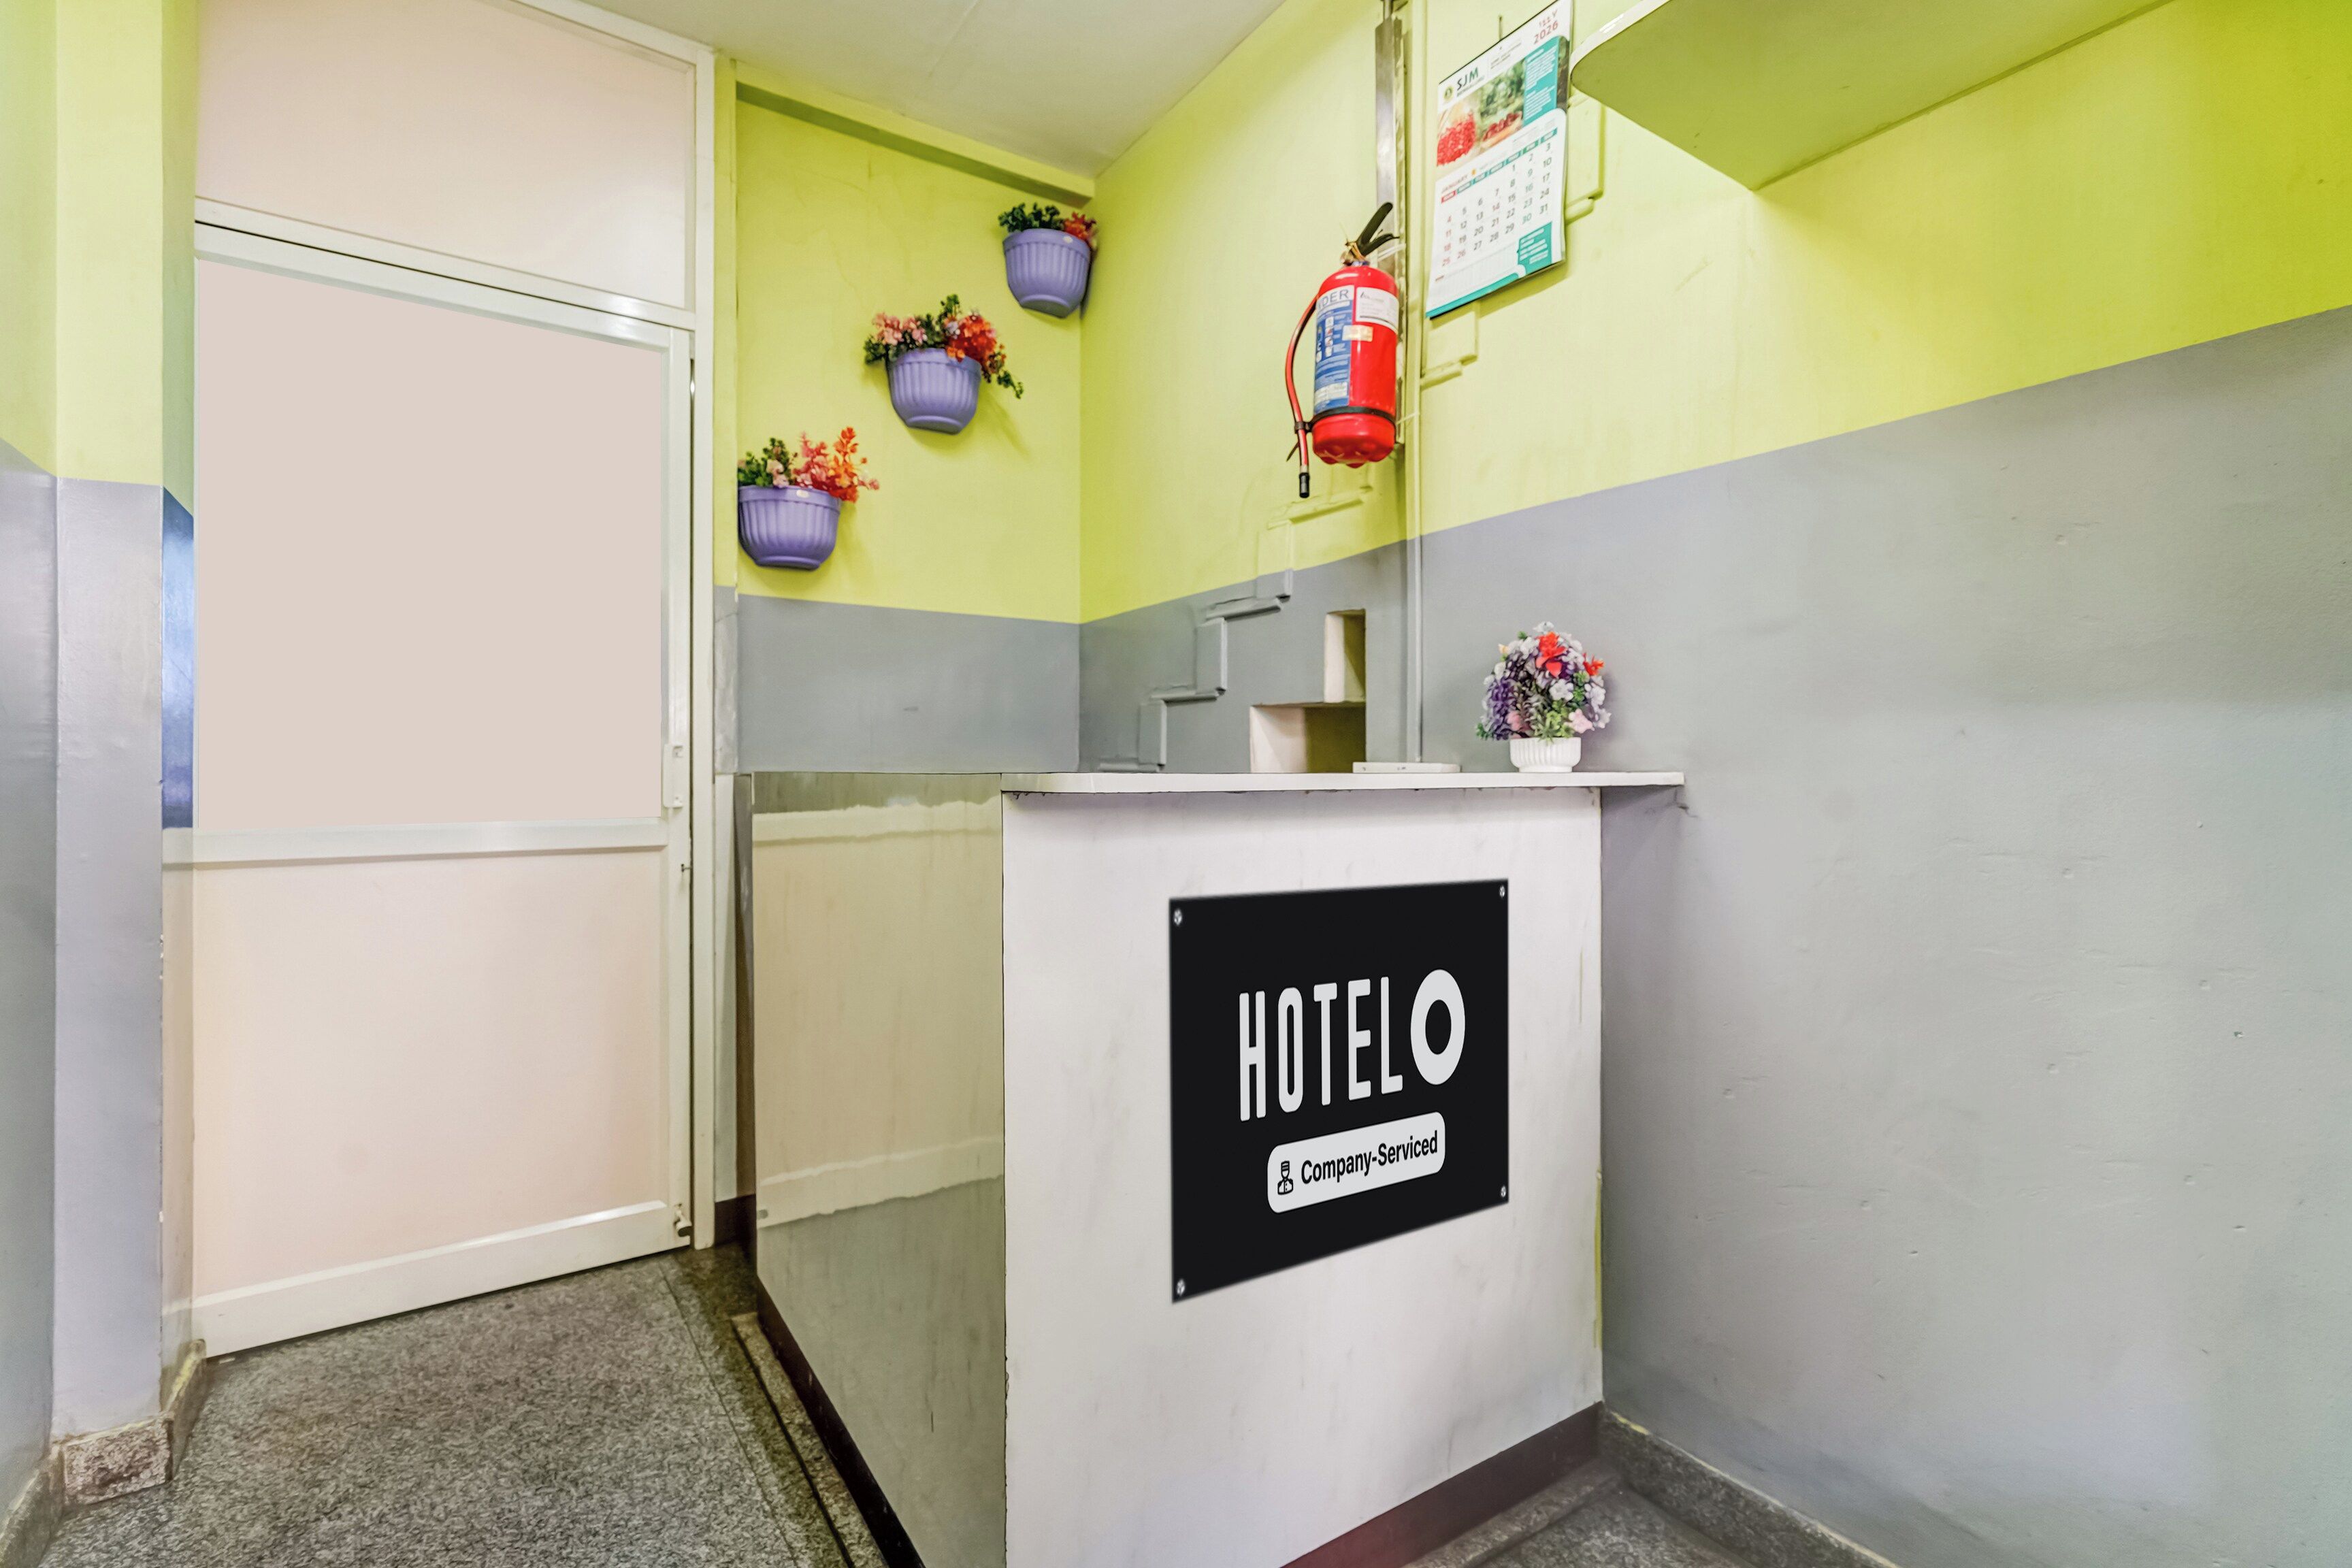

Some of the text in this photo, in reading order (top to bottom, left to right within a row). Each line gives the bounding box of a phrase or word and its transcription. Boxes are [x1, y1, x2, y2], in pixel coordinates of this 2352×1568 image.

[1533, 20, 1558, 44] 2026
[1457, 67, 1478, 91] SJM
[1543, 157, 1552, 167] 10
[1444, 188, 1550, 251] 18 19 20 21 22 23 24
[1446, 172, 1550, 237] 11 12 13 14 15 16 17
[1442, 203, 1548, 266] 25 26 27 28 29 30 31
[1301, 1130, 1438, 1185] Company-Serviced
